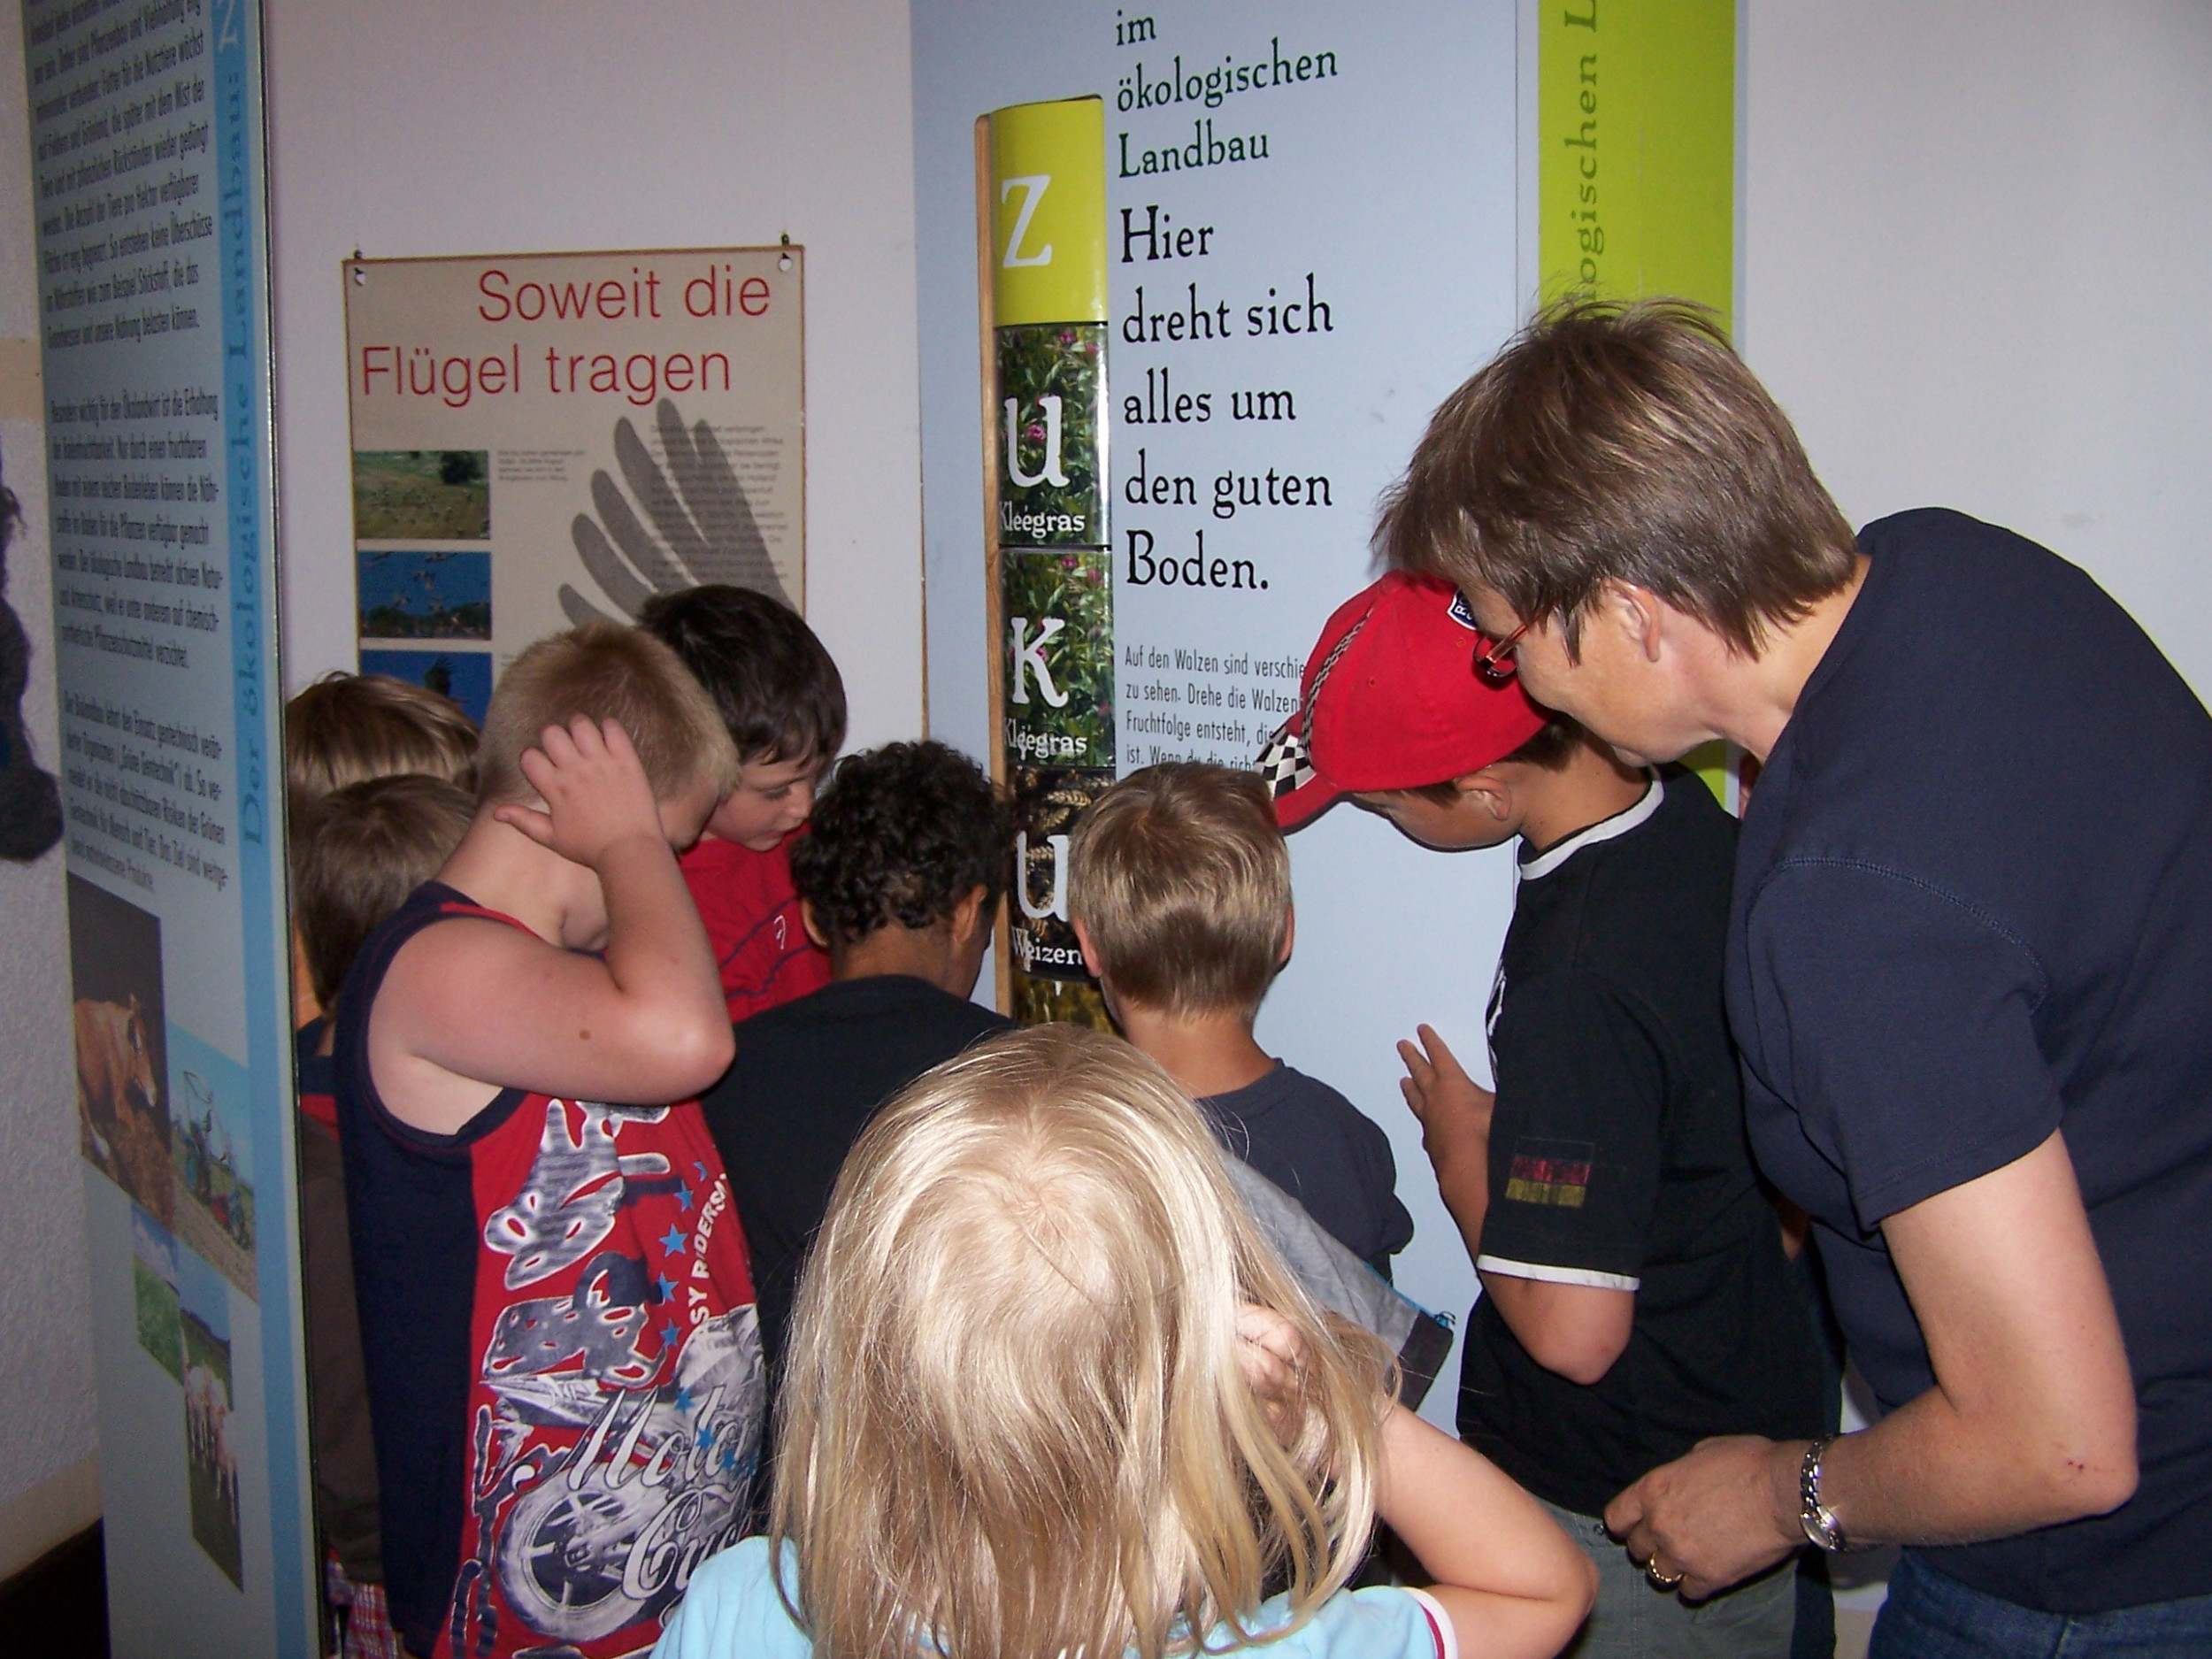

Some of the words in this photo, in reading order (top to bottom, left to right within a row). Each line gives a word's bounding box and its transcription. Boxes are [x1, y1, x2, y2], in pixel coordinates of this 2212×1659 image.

[1116, 9, 1156, 46] im
[1118, 36, 1338, 111] ökologischen
[1118, 119, 1270, 178] Landbau
[1121, 204, 1214, 263] Hier
[478, 266, 662, 322] Soweit
[684, 264, 771, 317] die
[1123, 281, 1231, 343] dreht
[1247, 273, 1333, 336] sich
[362, 343, 520, 408] Flügel
[545, 346, 731, 406] tragen
[1124, 367, 1212, 425] alles
[1231, 389, 1297, 421] um
[1125, 448, 1197, 505] den
[1213, 467, 1333, 518] guten
[999, 500, 1086, 539] Kleegras
[1125, 529, 1270, 590] Boden.
[1125, 645, 1144, 666] Auf
[1149, 646, 1170, 669] den
[1175, 649, 1218, 672] Walzen
[1225, 652, 1248, 675] sind
[1125, 683, 1140, 699] zu
[1144, 680, 1181, 703] sehen.
[1187, 682, 1222, 707] Drehe
[1228, 686, 1247, 709] die
[1252, 688, 1298, 713] Walzen
[1003, 717, 1088, 758] Kleegras
[1126, 744, 1145, 764] ist.
[1127, 710, 1191, 741] Fruchtfolge
[1196, 720, 1251, 747] entsteht,
[1011, 926, 1084, 965] Weizen
